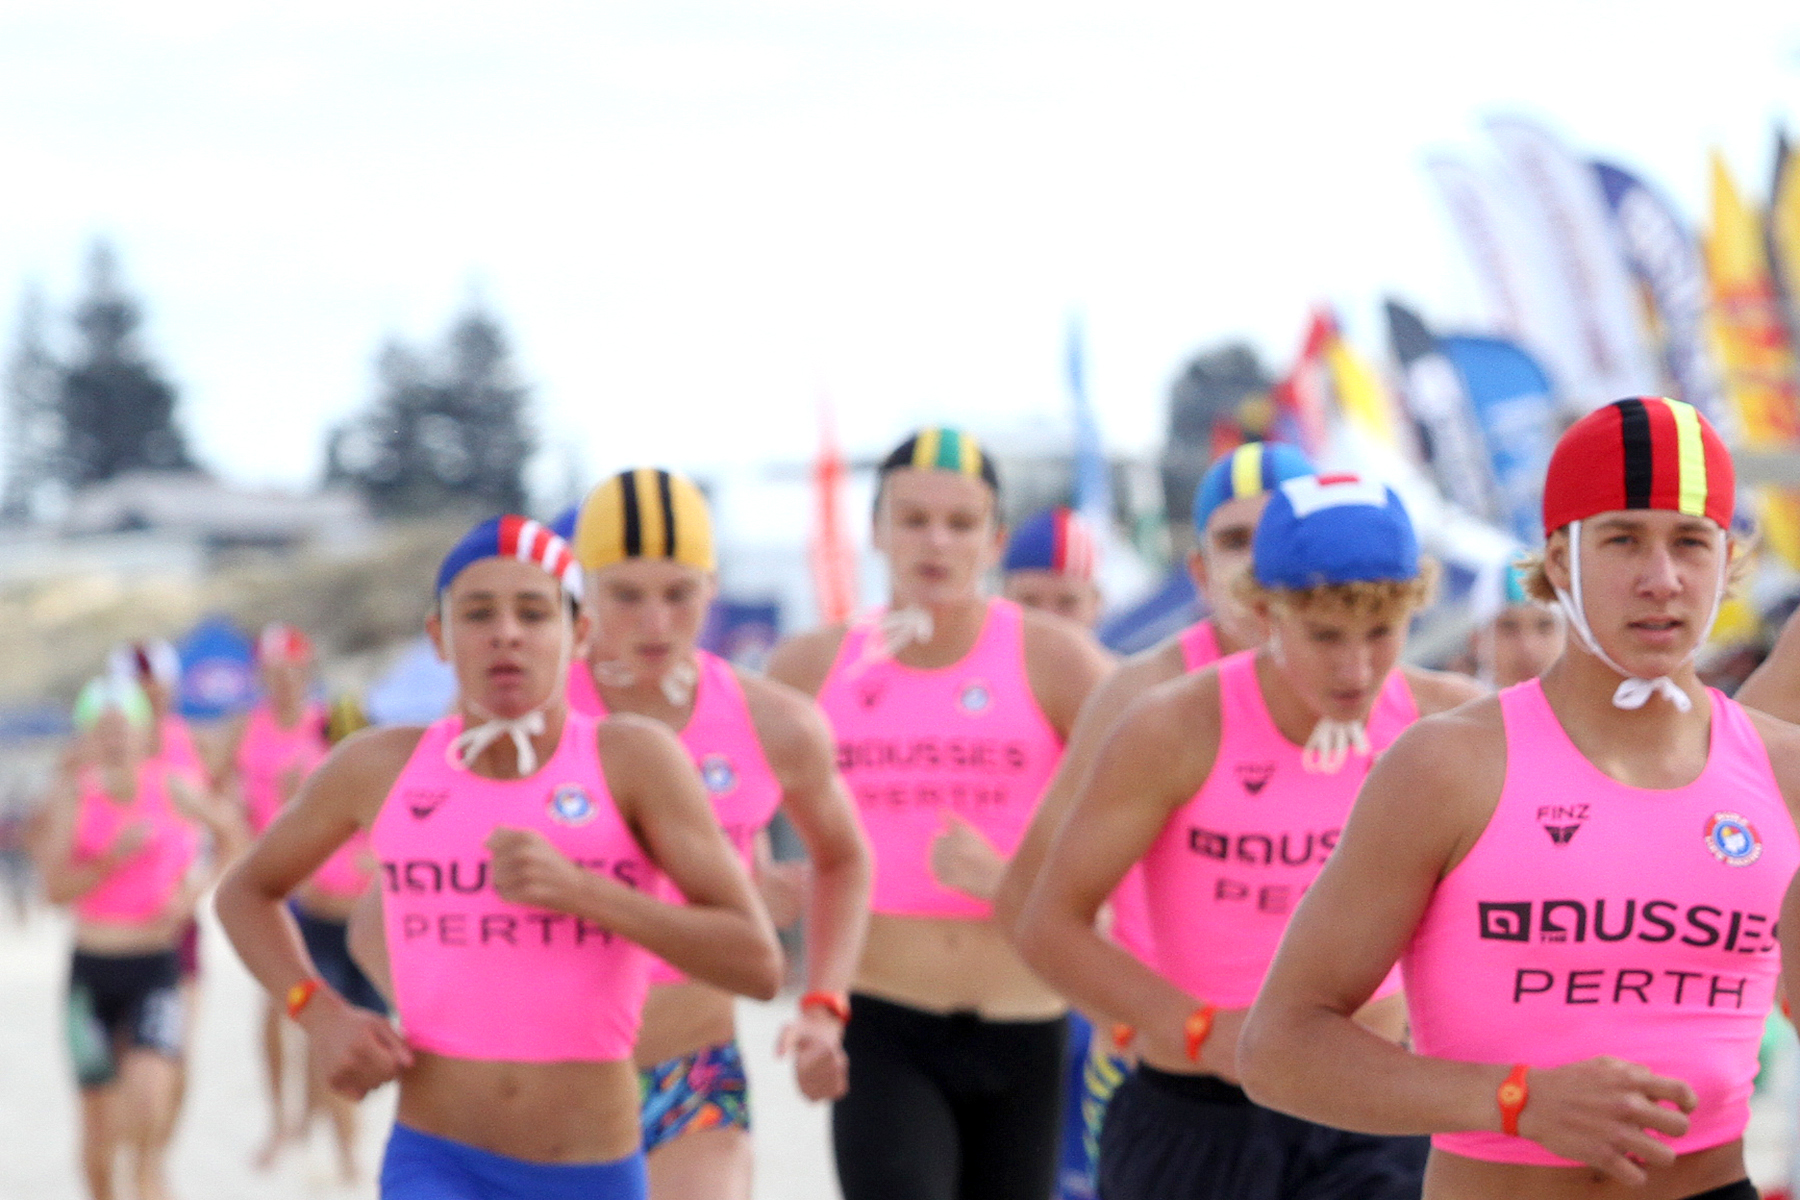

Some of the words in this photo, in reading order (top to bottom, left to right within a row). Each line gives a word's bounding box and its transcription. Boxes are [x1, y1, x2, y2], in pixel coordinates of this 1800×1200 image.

[1536, 804, 1590, 820] FINZ
[404, 912, 613, 945] PERTH
[1513, 969, 1747, 1009] PERTH
